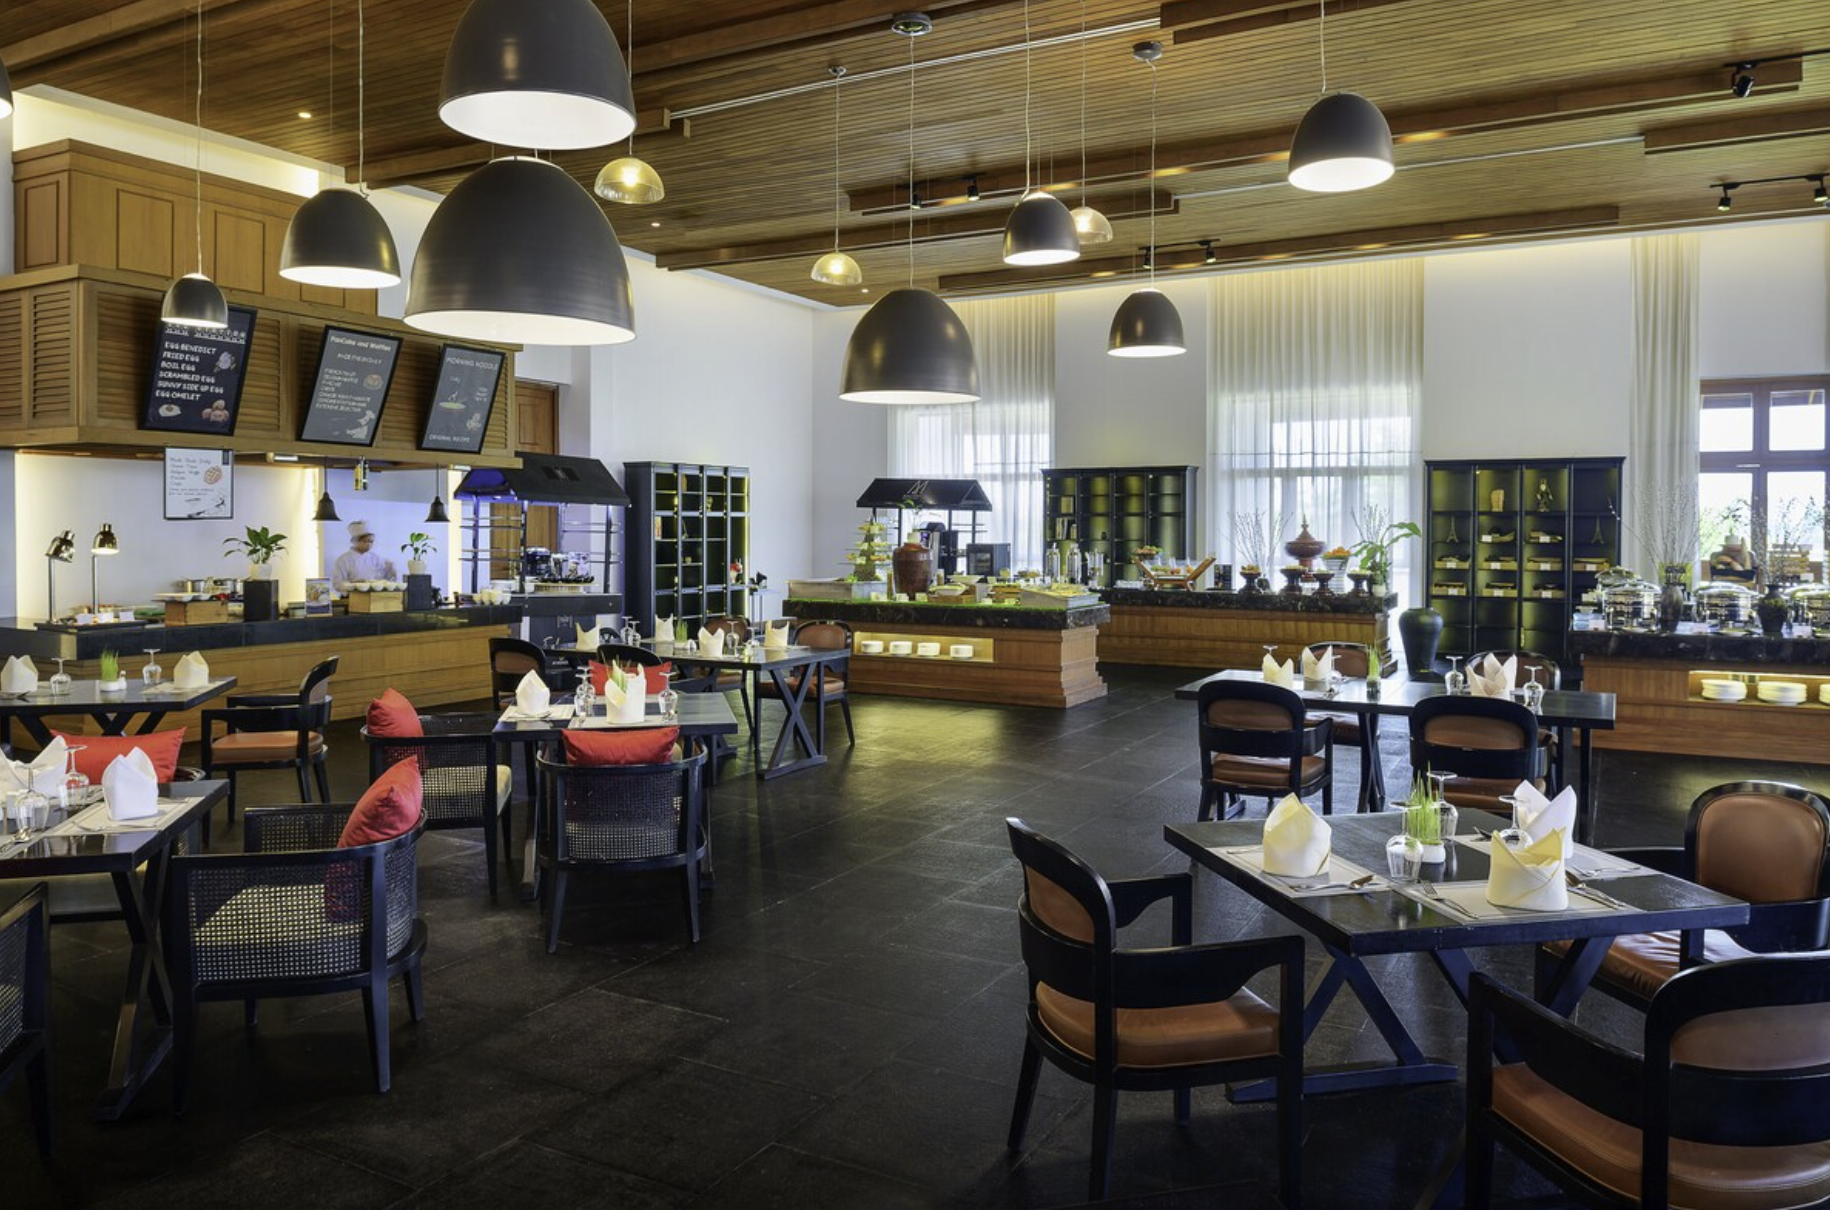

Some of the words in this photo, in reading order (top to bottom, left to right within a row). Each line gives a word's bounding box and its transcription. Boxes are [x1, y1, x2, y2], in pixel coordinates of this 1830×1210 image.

[165, 341, 179, 351] EGG
[180, 343, 217, 355] BENEDICT
[162, 351, 184, 360] FRIED
[185, 353, 200, 362] EGG
[160, 361, 180, 370] BOIL
[181, 363, 196, 372] EGG
[158, 371, 200, 382] SCRAMBLED
[200, 374, 216, 384] EGG
[157, 380, 181, 389] SUNNY
[182, 382, 199, 391] SIDE
[200, 384, 210, 392] UP
[210, 384, 224, 394] EGG
[155, 389, 171, 399] EGG
[171, 391, 201, 401] OMELET
